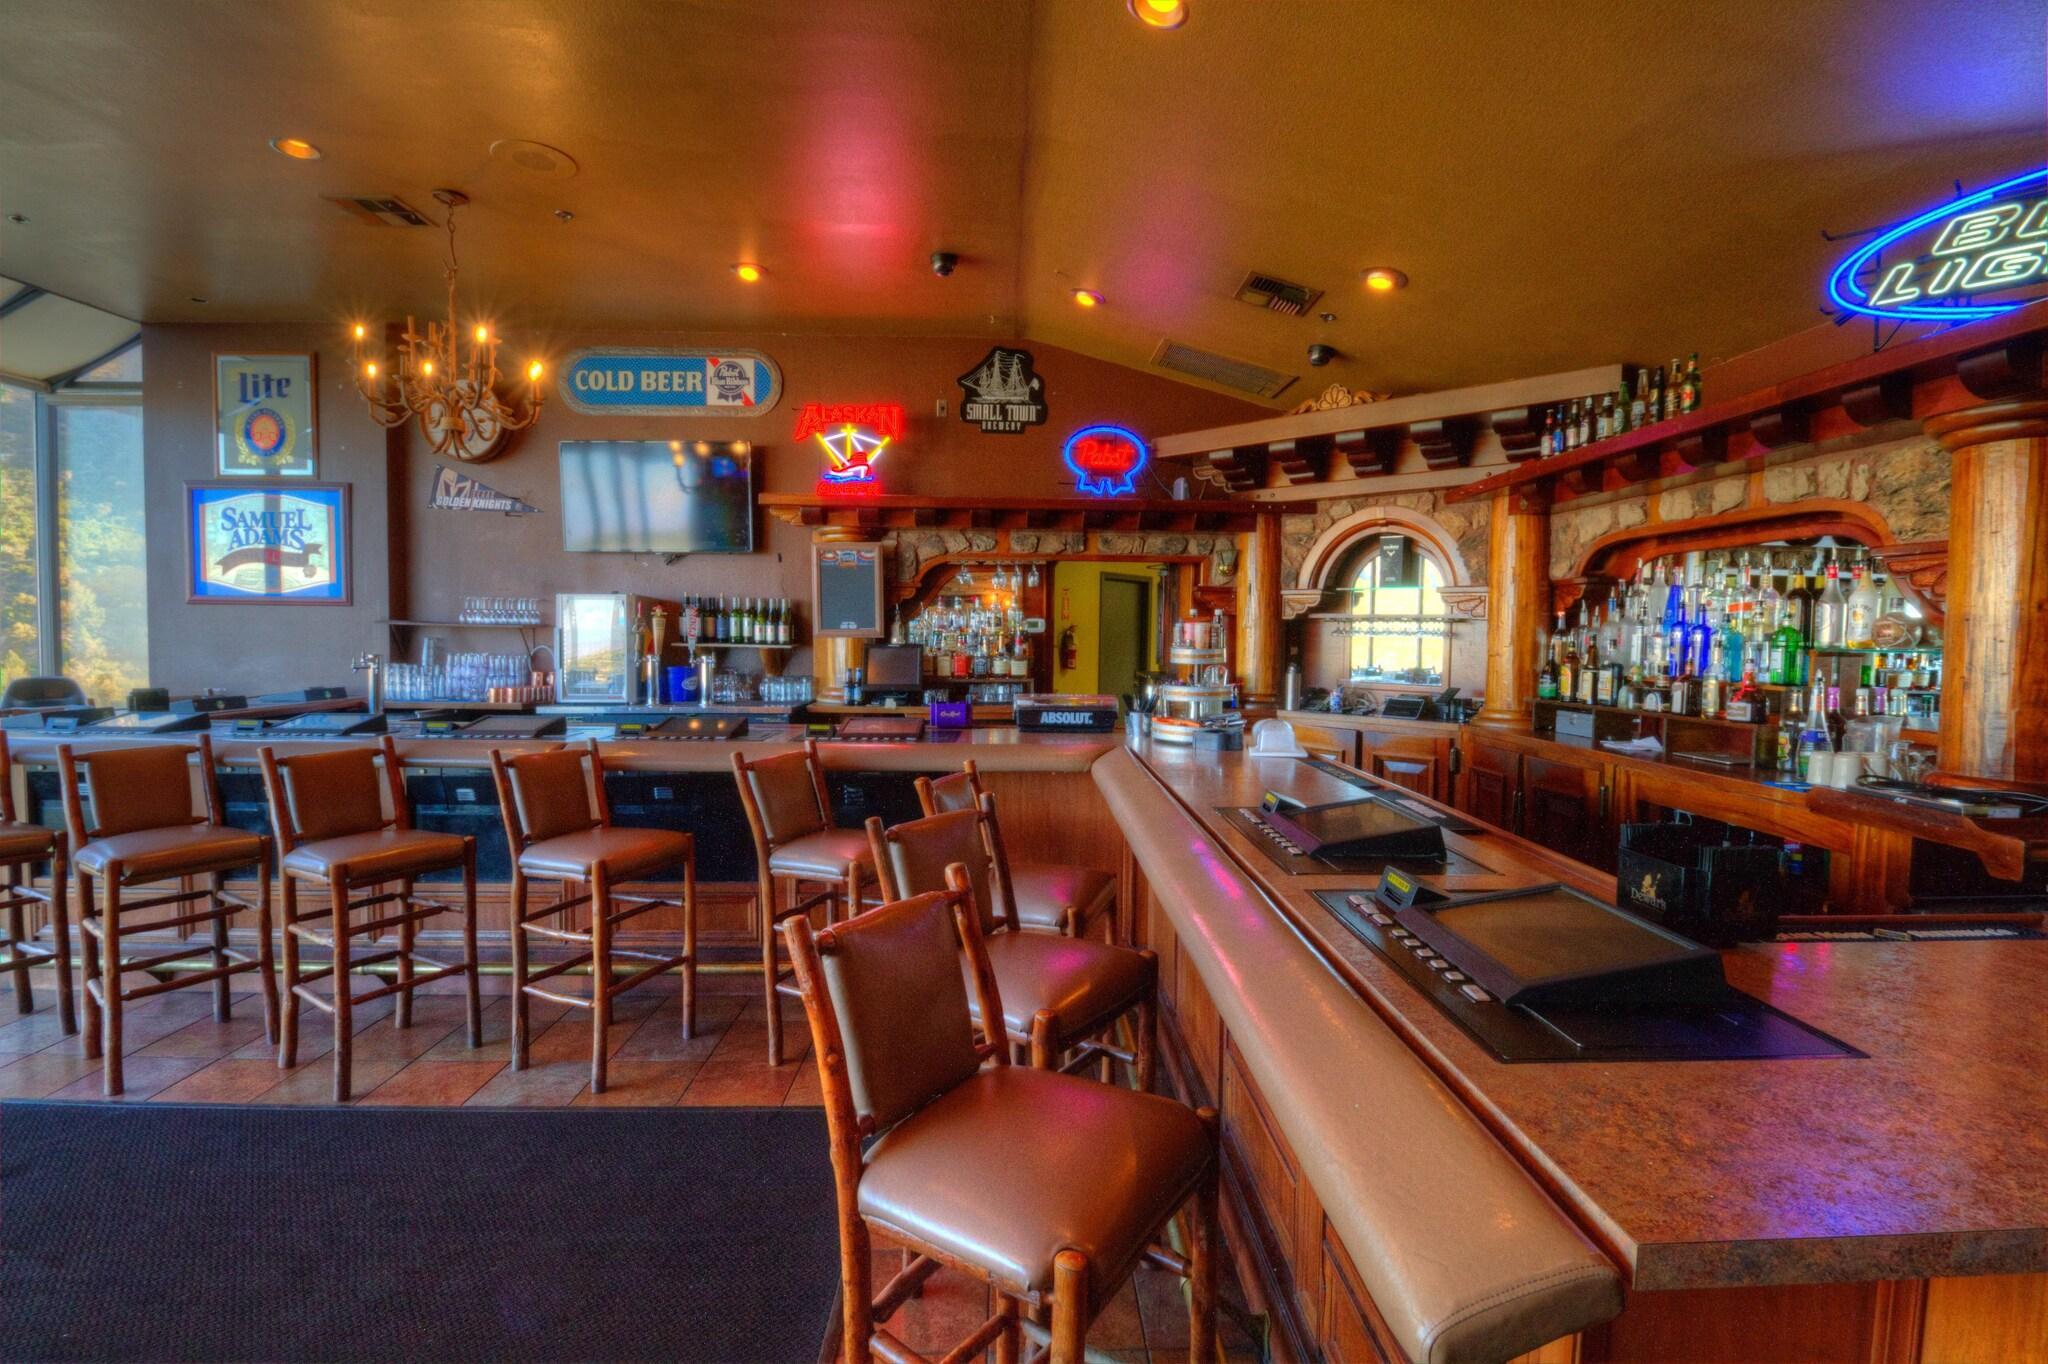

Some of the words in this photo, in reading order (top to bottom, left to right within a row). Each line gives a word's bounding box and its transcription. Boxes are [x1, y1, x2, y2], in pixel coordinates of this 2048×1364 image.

[1867, 241, 2048, 307] LIG
[238, 372, 291, 406] Lite
[575, 370, 635, 392] COLD
[640, 370, 704, 393] BEER
[794, 404, 901, 441] ALASKAN
[966, 403, 1003, 421] SMALL
[982, 421, 1022, 432] BREWERY
[1078, 440, 1135, 468] Pabst
[435, 495, 472, 508] GOLDEN
[472, 498, 513, 511] KNIGHTS
[220, 506, 313, 532] SAMUEL
[227, 527, 306, 552] ADAMS
